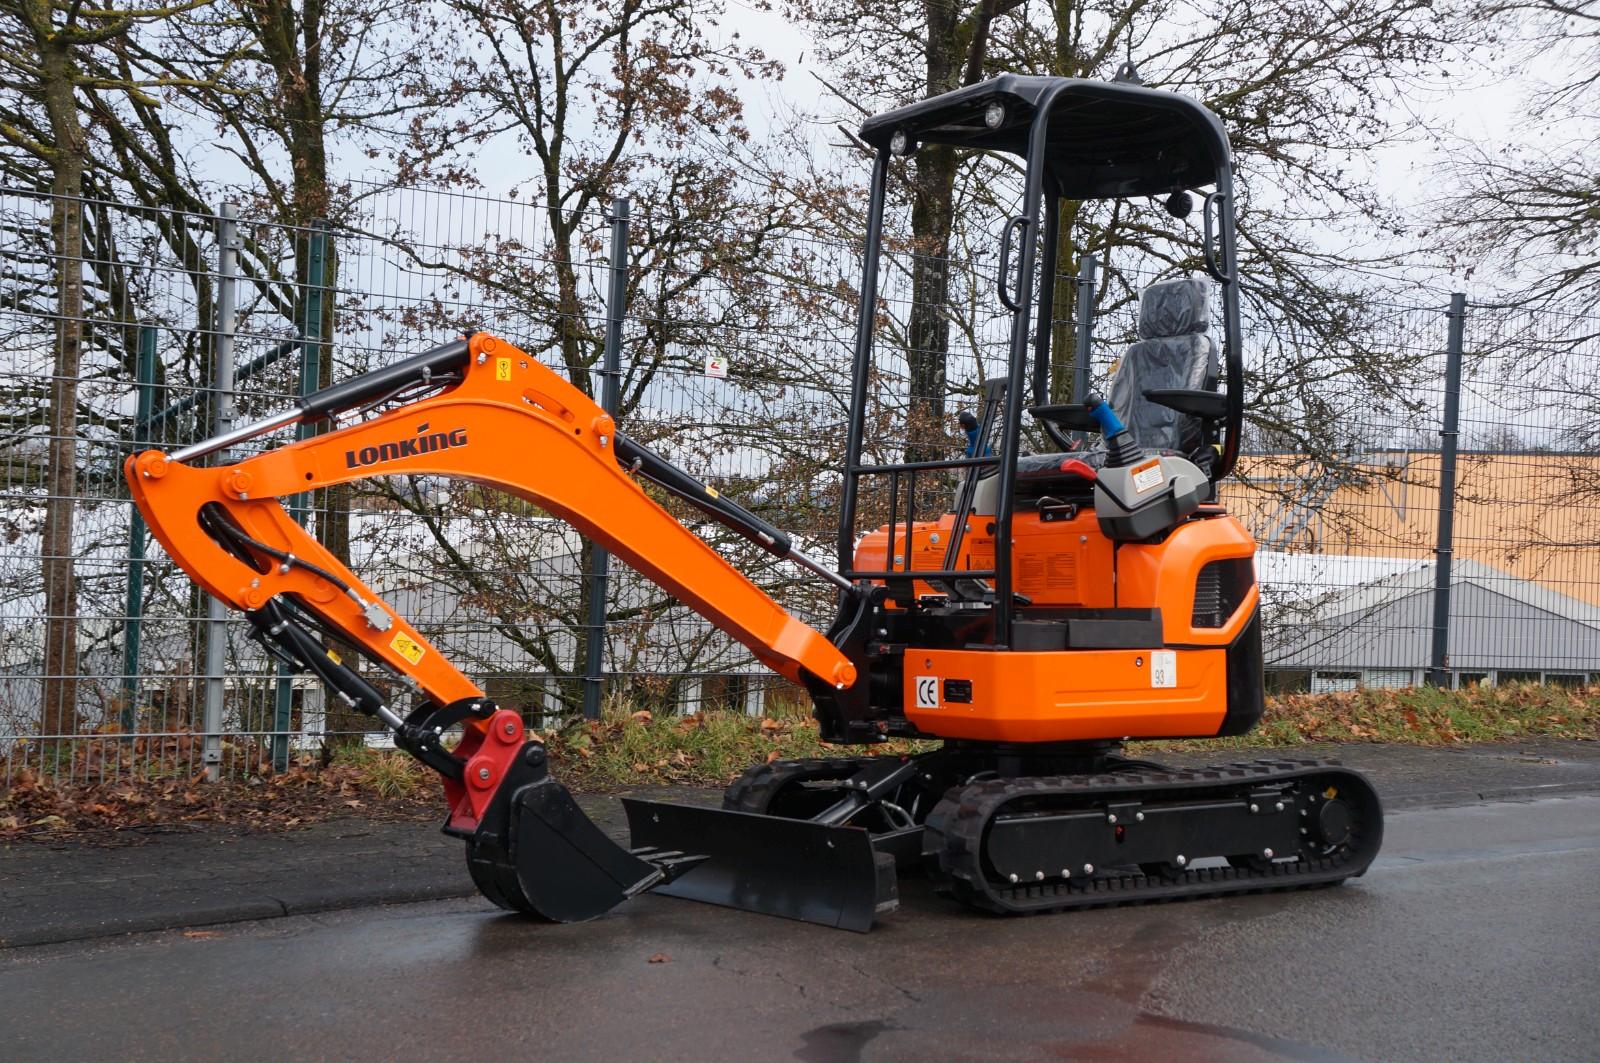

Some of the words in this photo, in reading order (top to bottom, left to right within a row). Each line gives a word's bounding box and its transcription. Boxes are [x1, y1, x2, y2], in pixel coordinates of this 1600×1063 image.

[346, 422, 468, 468] LONKING
[1155, 669, 1165, 685] 93
[919, 679, 935, 705] CE
